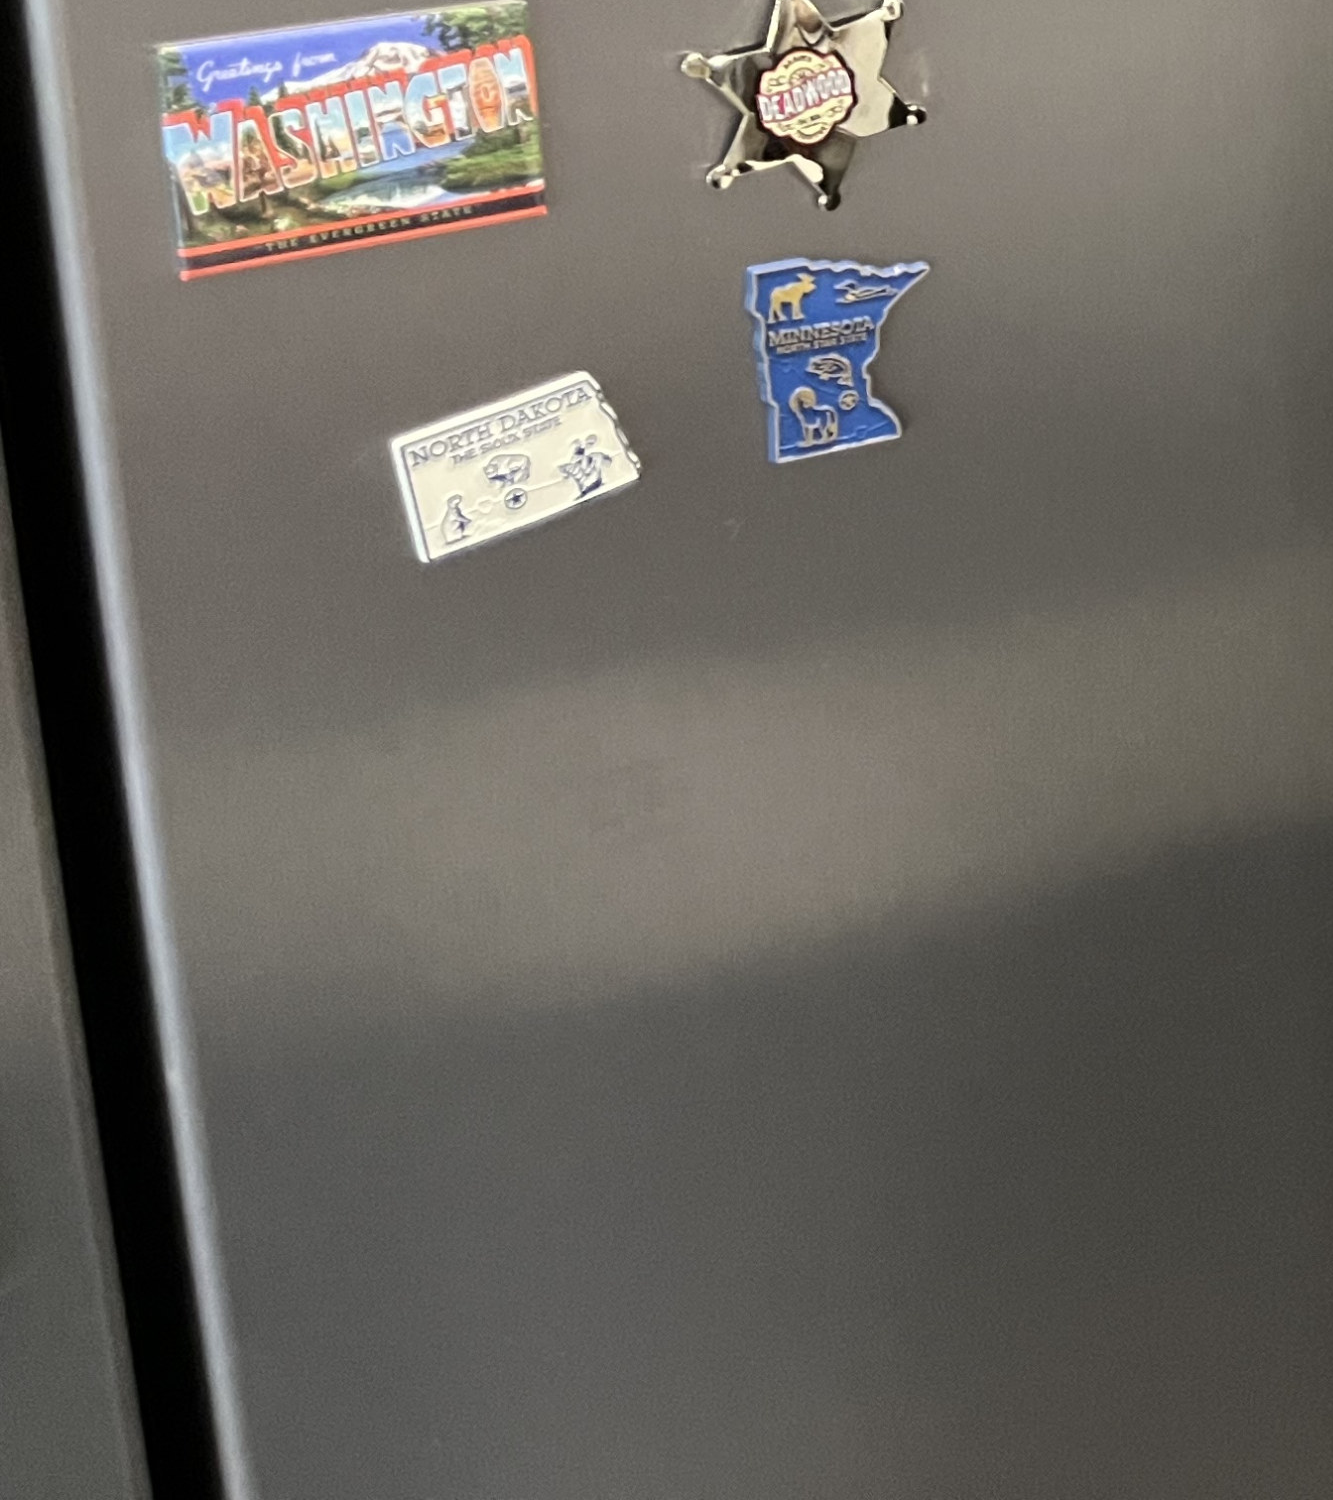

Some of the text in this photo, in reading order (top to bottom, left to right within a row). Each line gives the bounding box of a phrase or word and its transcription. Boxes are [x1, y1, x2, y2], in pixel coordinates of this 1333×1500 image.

[197, 51, 338, 92] Greetings from
[757, 69, 852, 121] DEADWOOD
[162, 40, 535, 216] WASHINGTON
[265, 206, 474, 252] THE EVERGREEN STATE
[768, 316, 875, 347] MINNESOTA
[408, 386, 592, 467] NORTH DAKOTA
